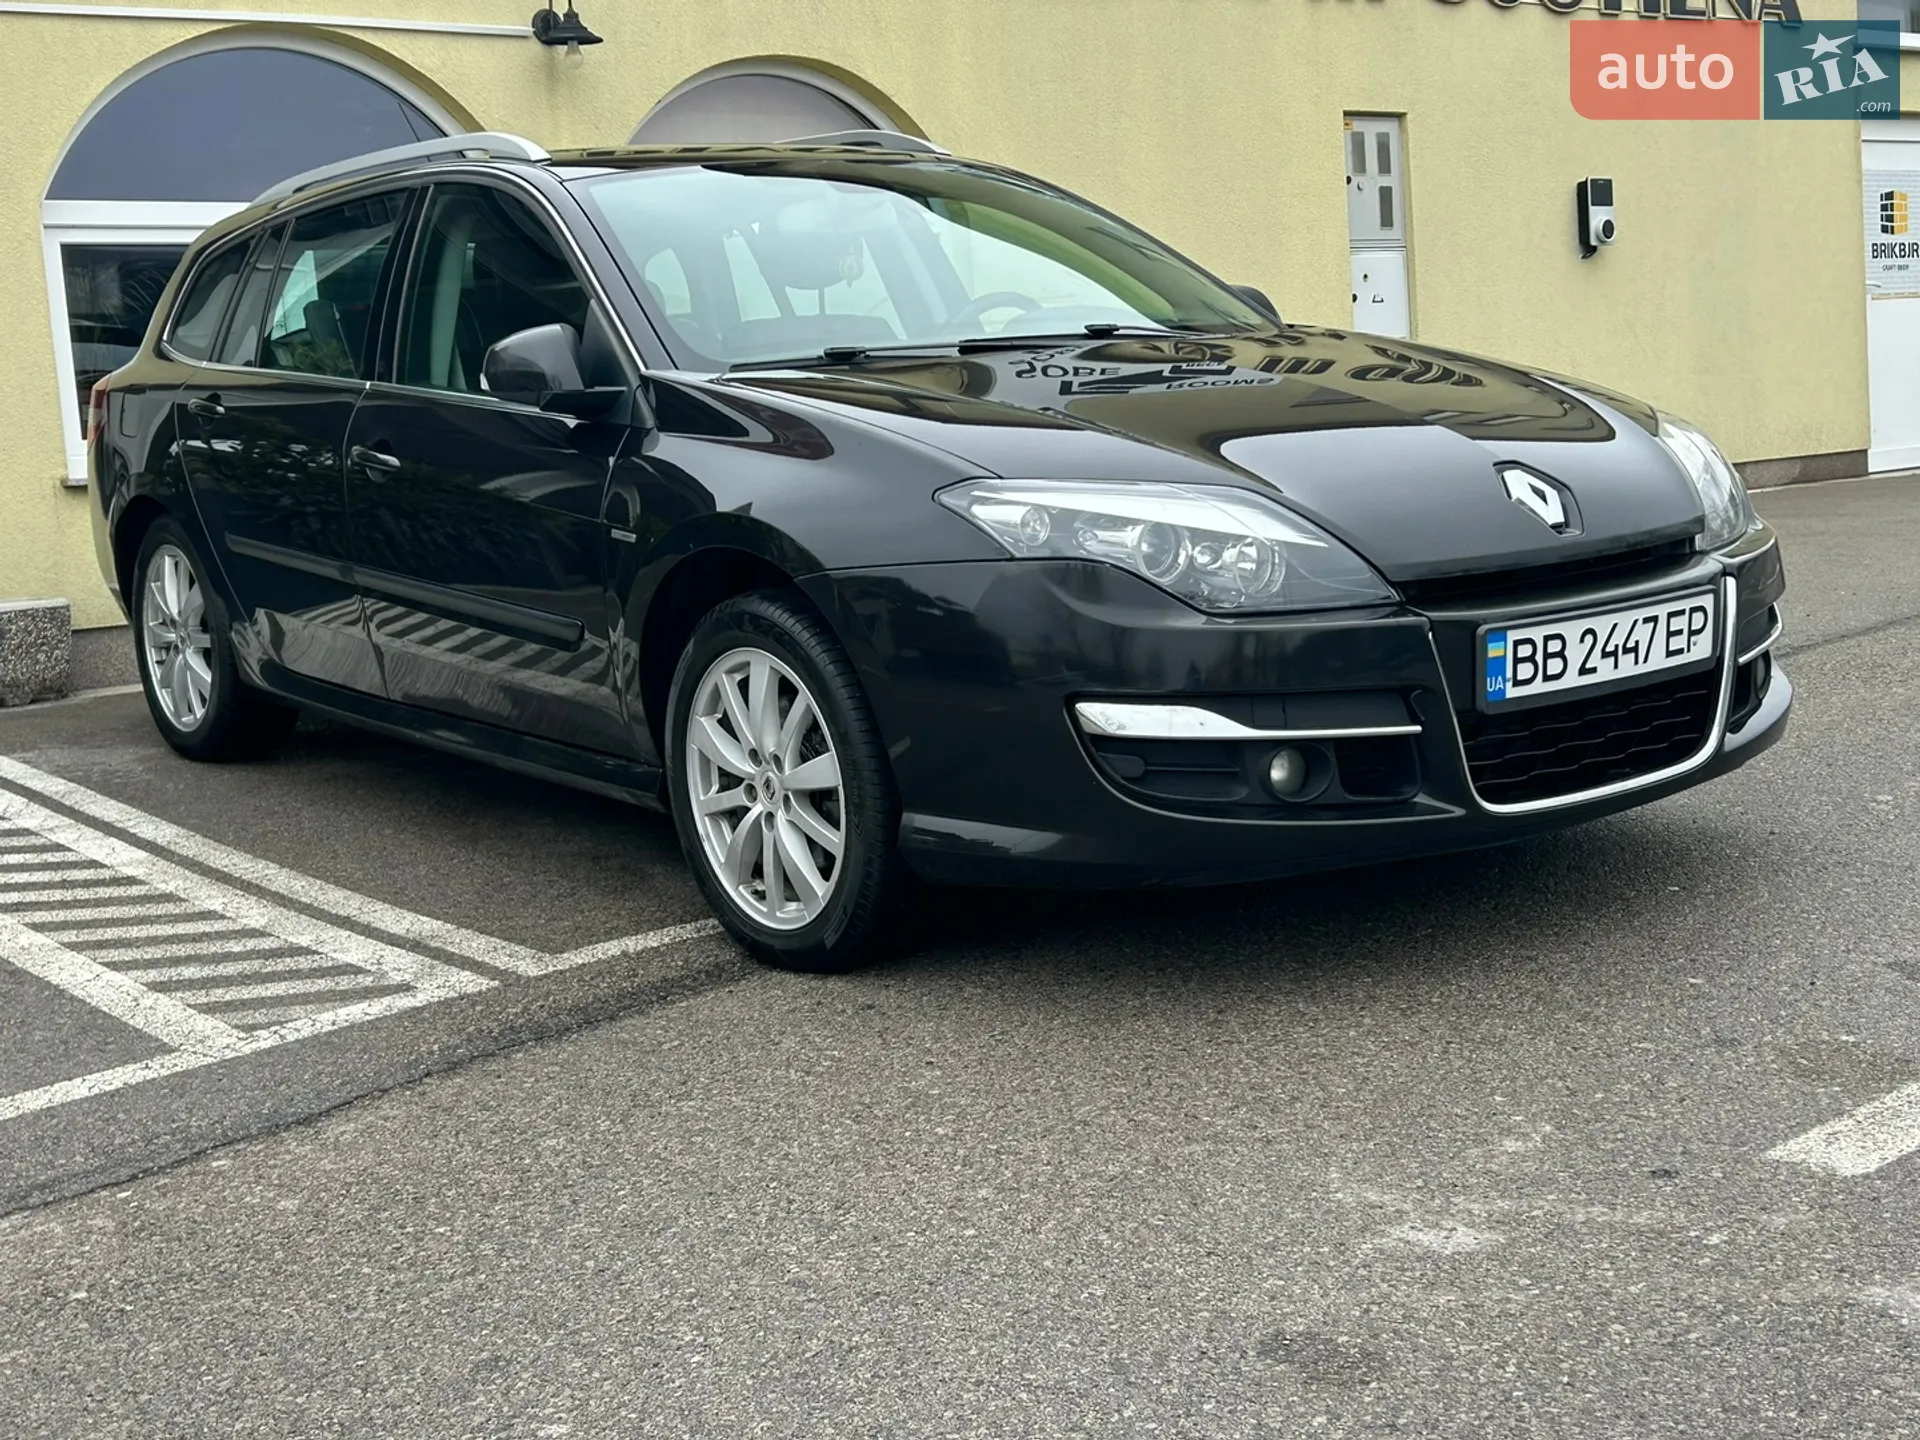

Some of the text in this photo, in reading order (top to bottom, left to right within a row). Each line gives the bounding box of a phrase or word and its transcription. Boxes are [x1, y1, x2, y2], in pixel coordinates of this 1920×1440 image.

[1512, 604, 1709, 688] BB 2447 EP
[1486, 675, 1505, 692] UA
